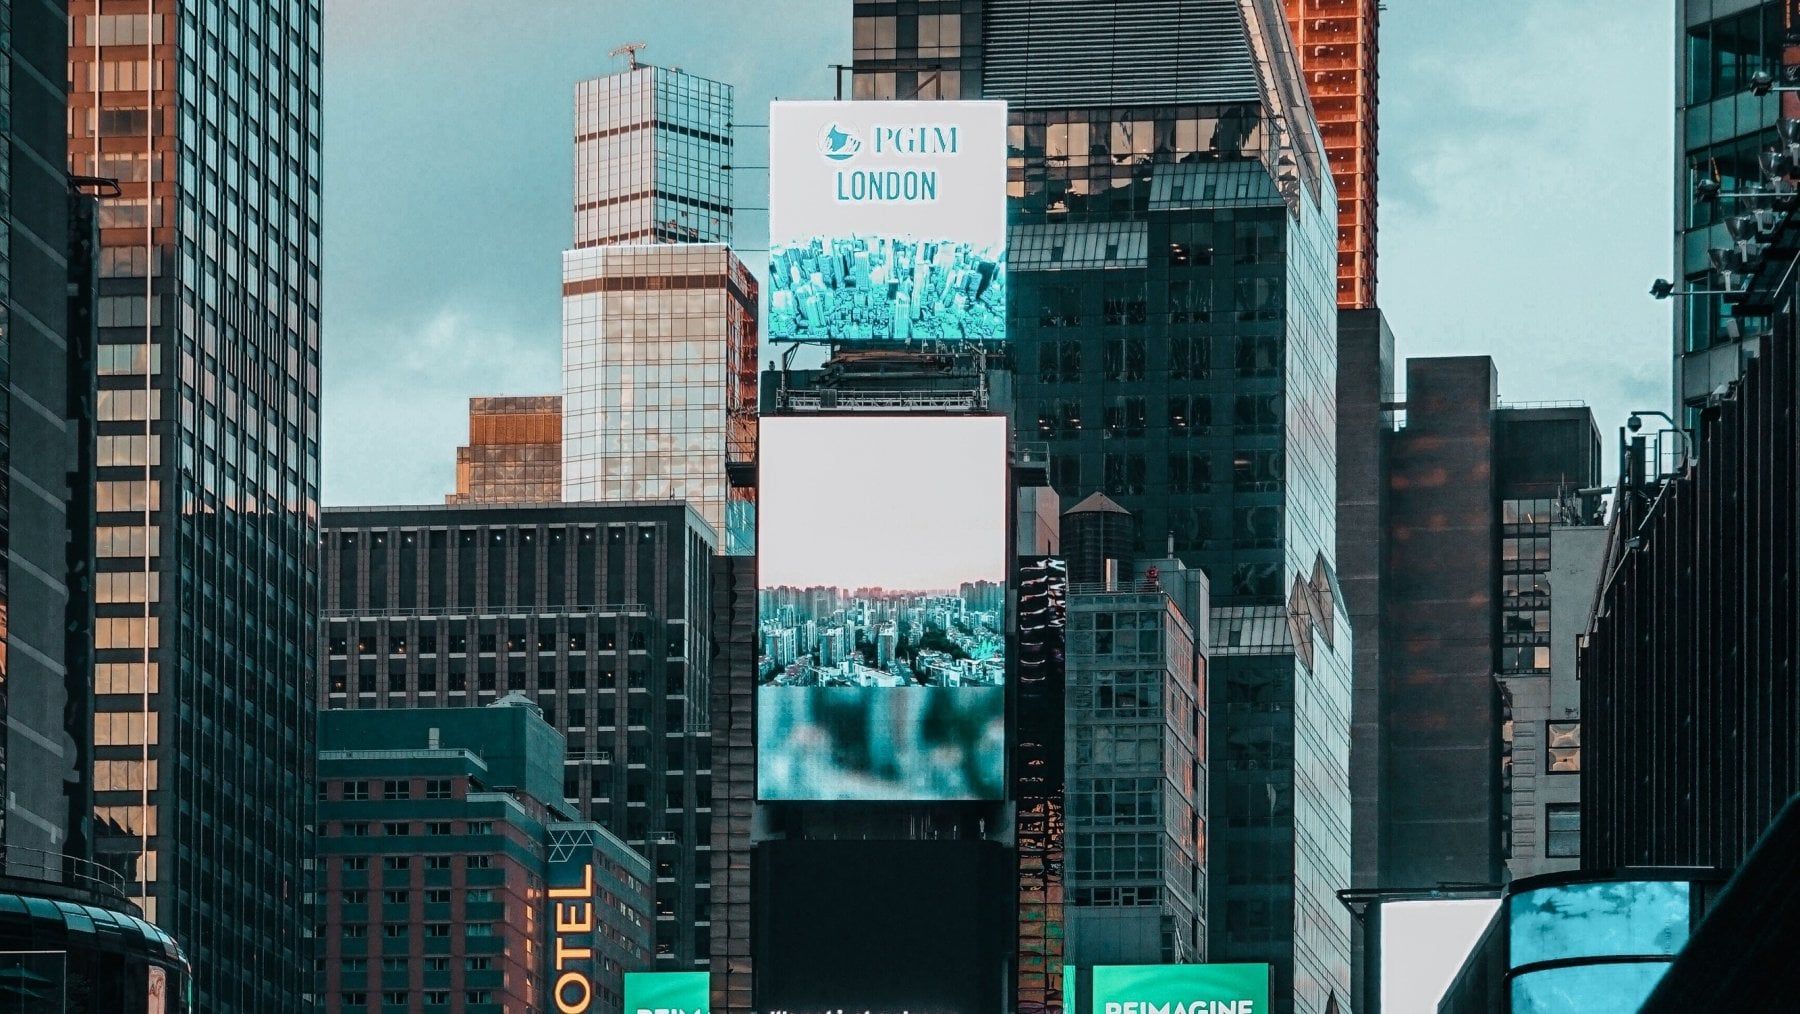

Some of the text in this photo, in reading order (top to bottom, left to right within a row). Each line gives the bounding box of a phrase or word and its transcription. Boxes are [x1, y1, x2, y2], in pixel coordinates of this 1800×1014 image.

[875, 126, 957, 153] PGIM
[837, 170, 936, 201] LONDON
[548, 864, 592, 1014] OTEL
